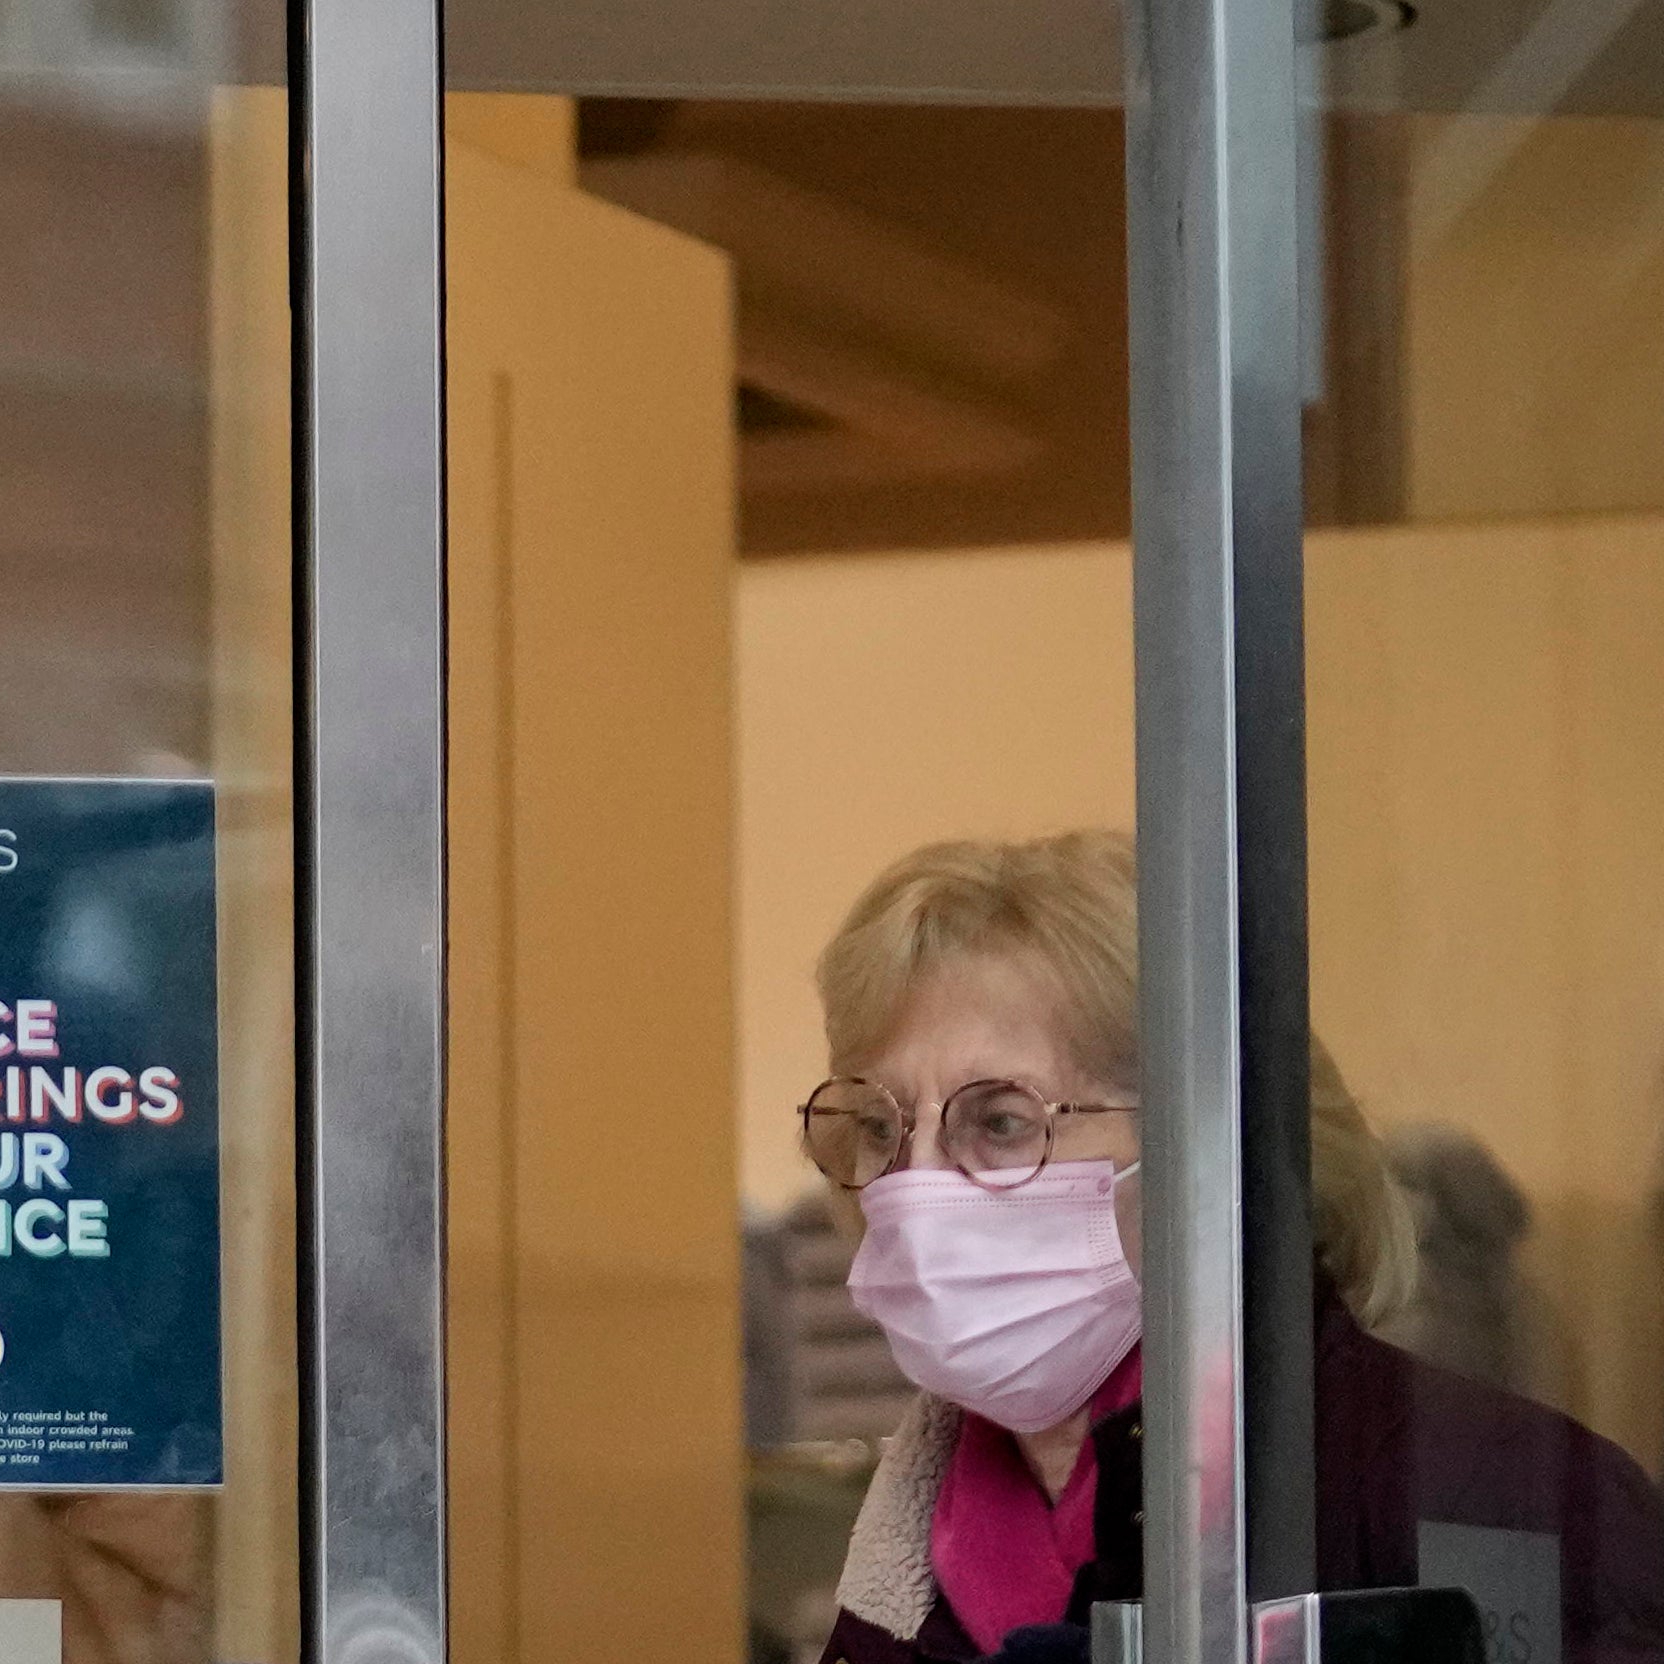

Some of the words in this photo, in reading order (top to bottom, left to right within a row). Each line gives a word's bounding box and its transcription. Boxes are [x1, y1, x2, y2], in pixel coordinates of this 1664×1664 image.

[13, 1410, 62, 1423] required
[65, 1410, 86, 1421] but
[89, 1410, 108, 1421] the
[7, 1424, 45, 1435] indoor
[48, 1424, 98, 1435] crowded
[48, 1438, 86, 1451] please
[89, 1438, 128, 1450] refrain
[10, 1453, 40, 1464] store
